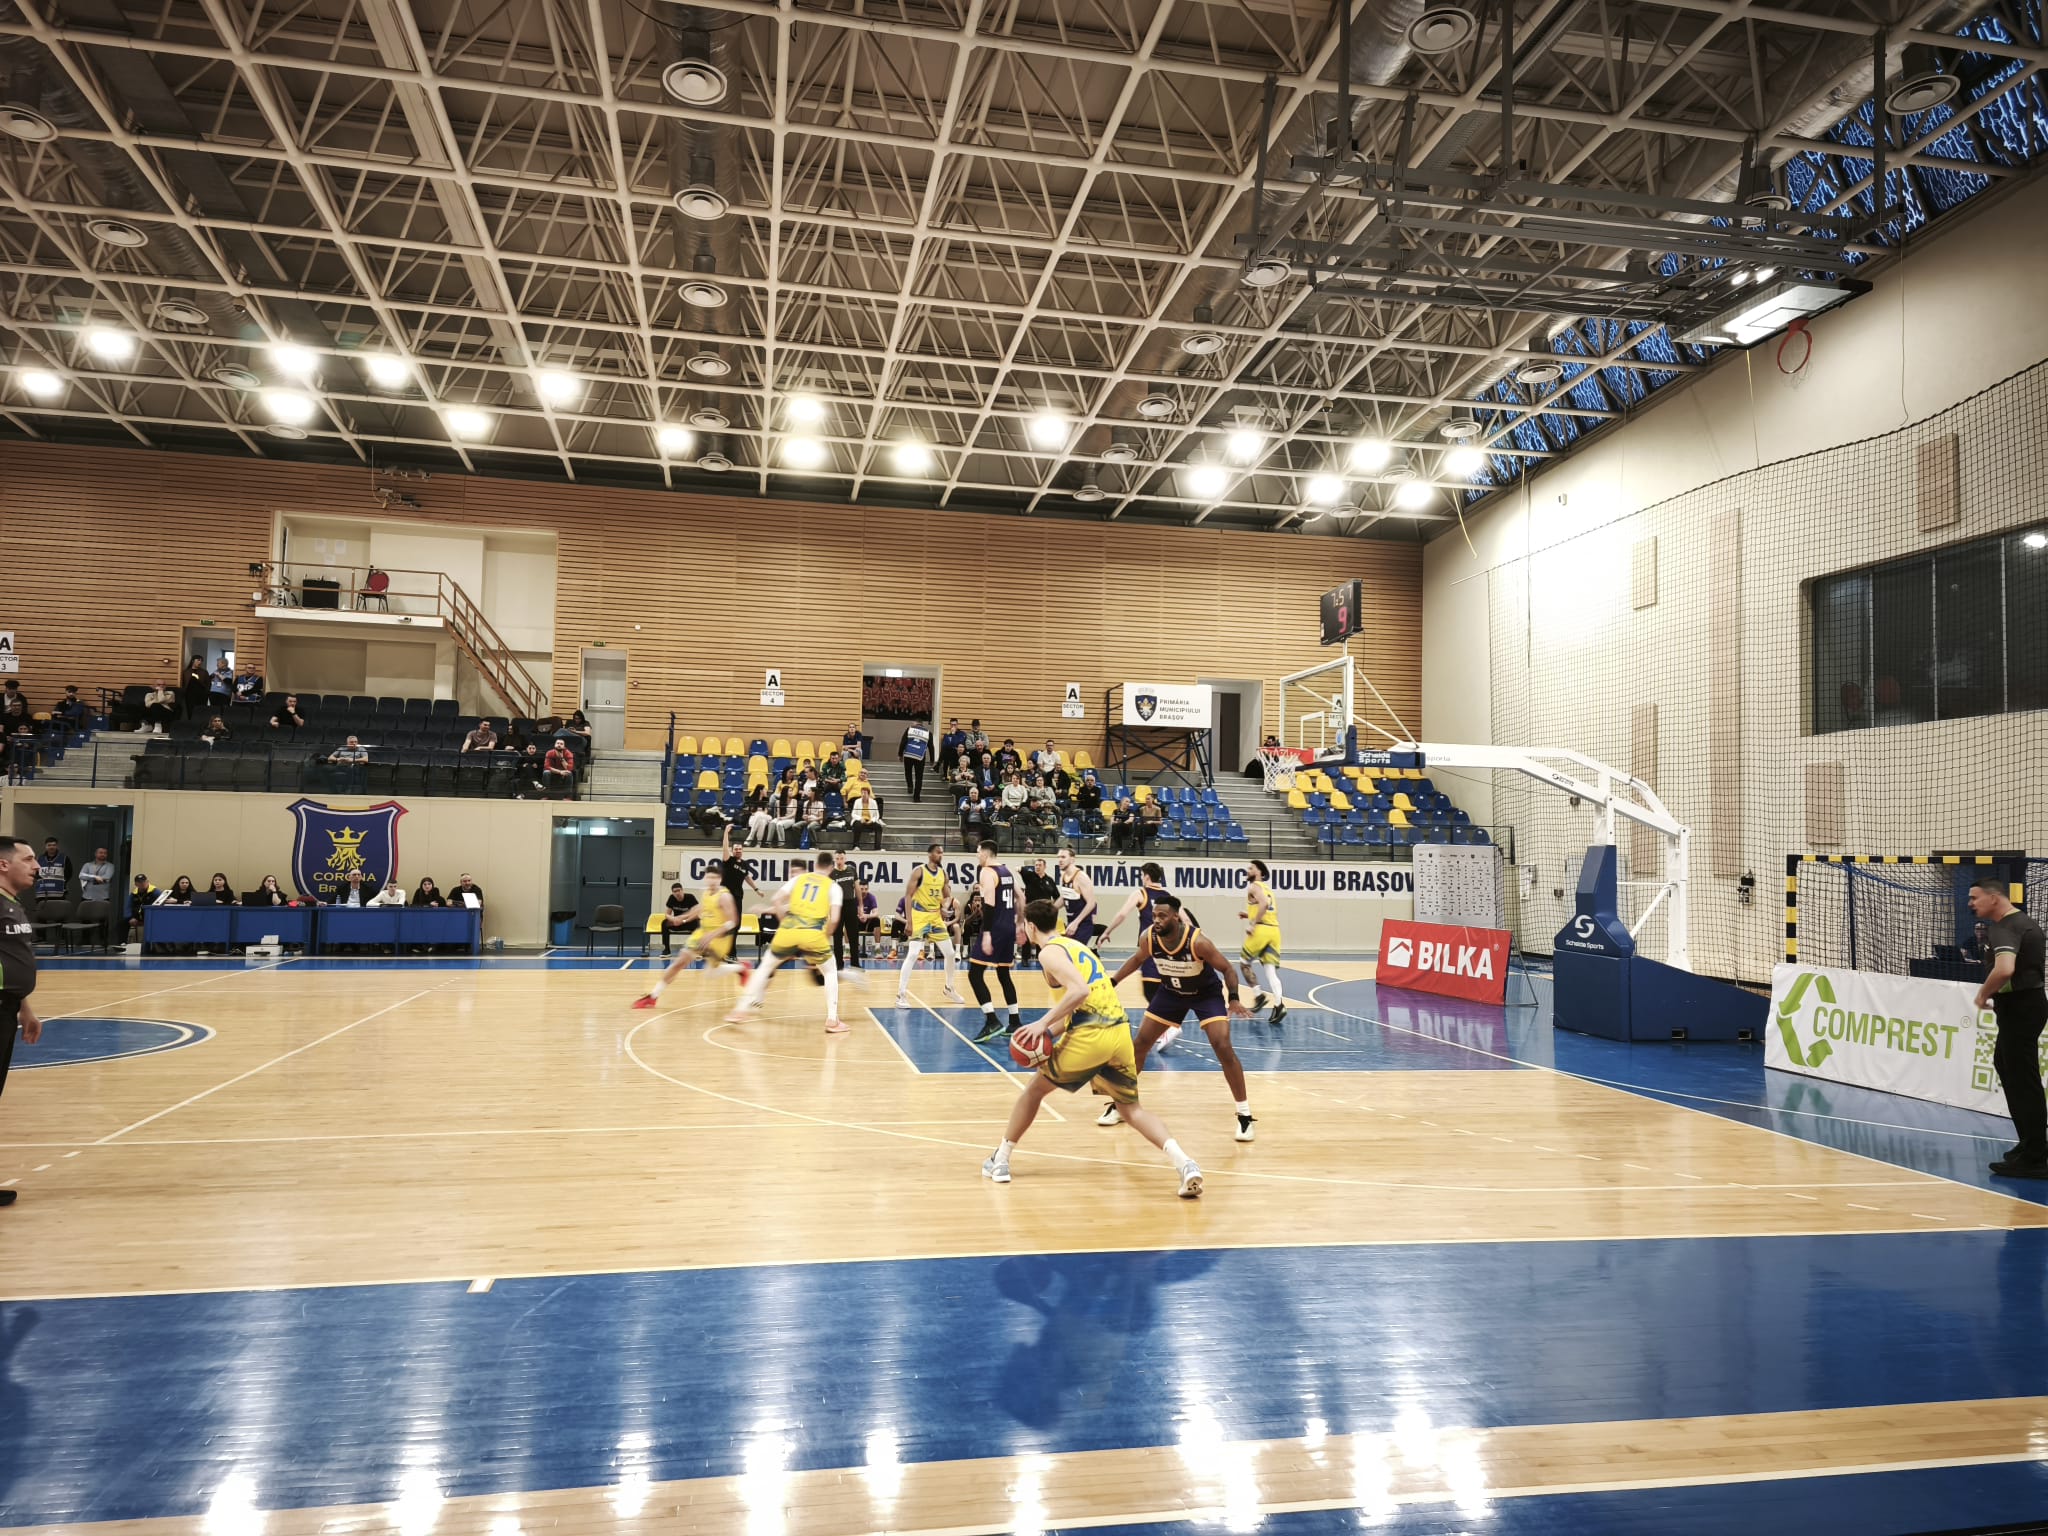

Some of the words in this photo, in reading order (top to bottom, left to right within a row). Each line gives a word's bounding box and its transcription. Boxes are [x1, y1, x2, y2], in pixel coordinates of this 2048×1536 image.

[1338, 606, 1347, 634] 9
[0, 637, 11, 651] A
[768, 675, 778, 686] A
[1068, 688, 1077, 699] A
[801, 883, 820, 902] 11
[929, 888, 940, 897] 32
[1078, 951, 1104, 984] 2
[1417, 941, 1494, 980] BILKA
[1171, 977, 1182, 989] 8
[1813, 1006, 1959, 1059] COMPREST
